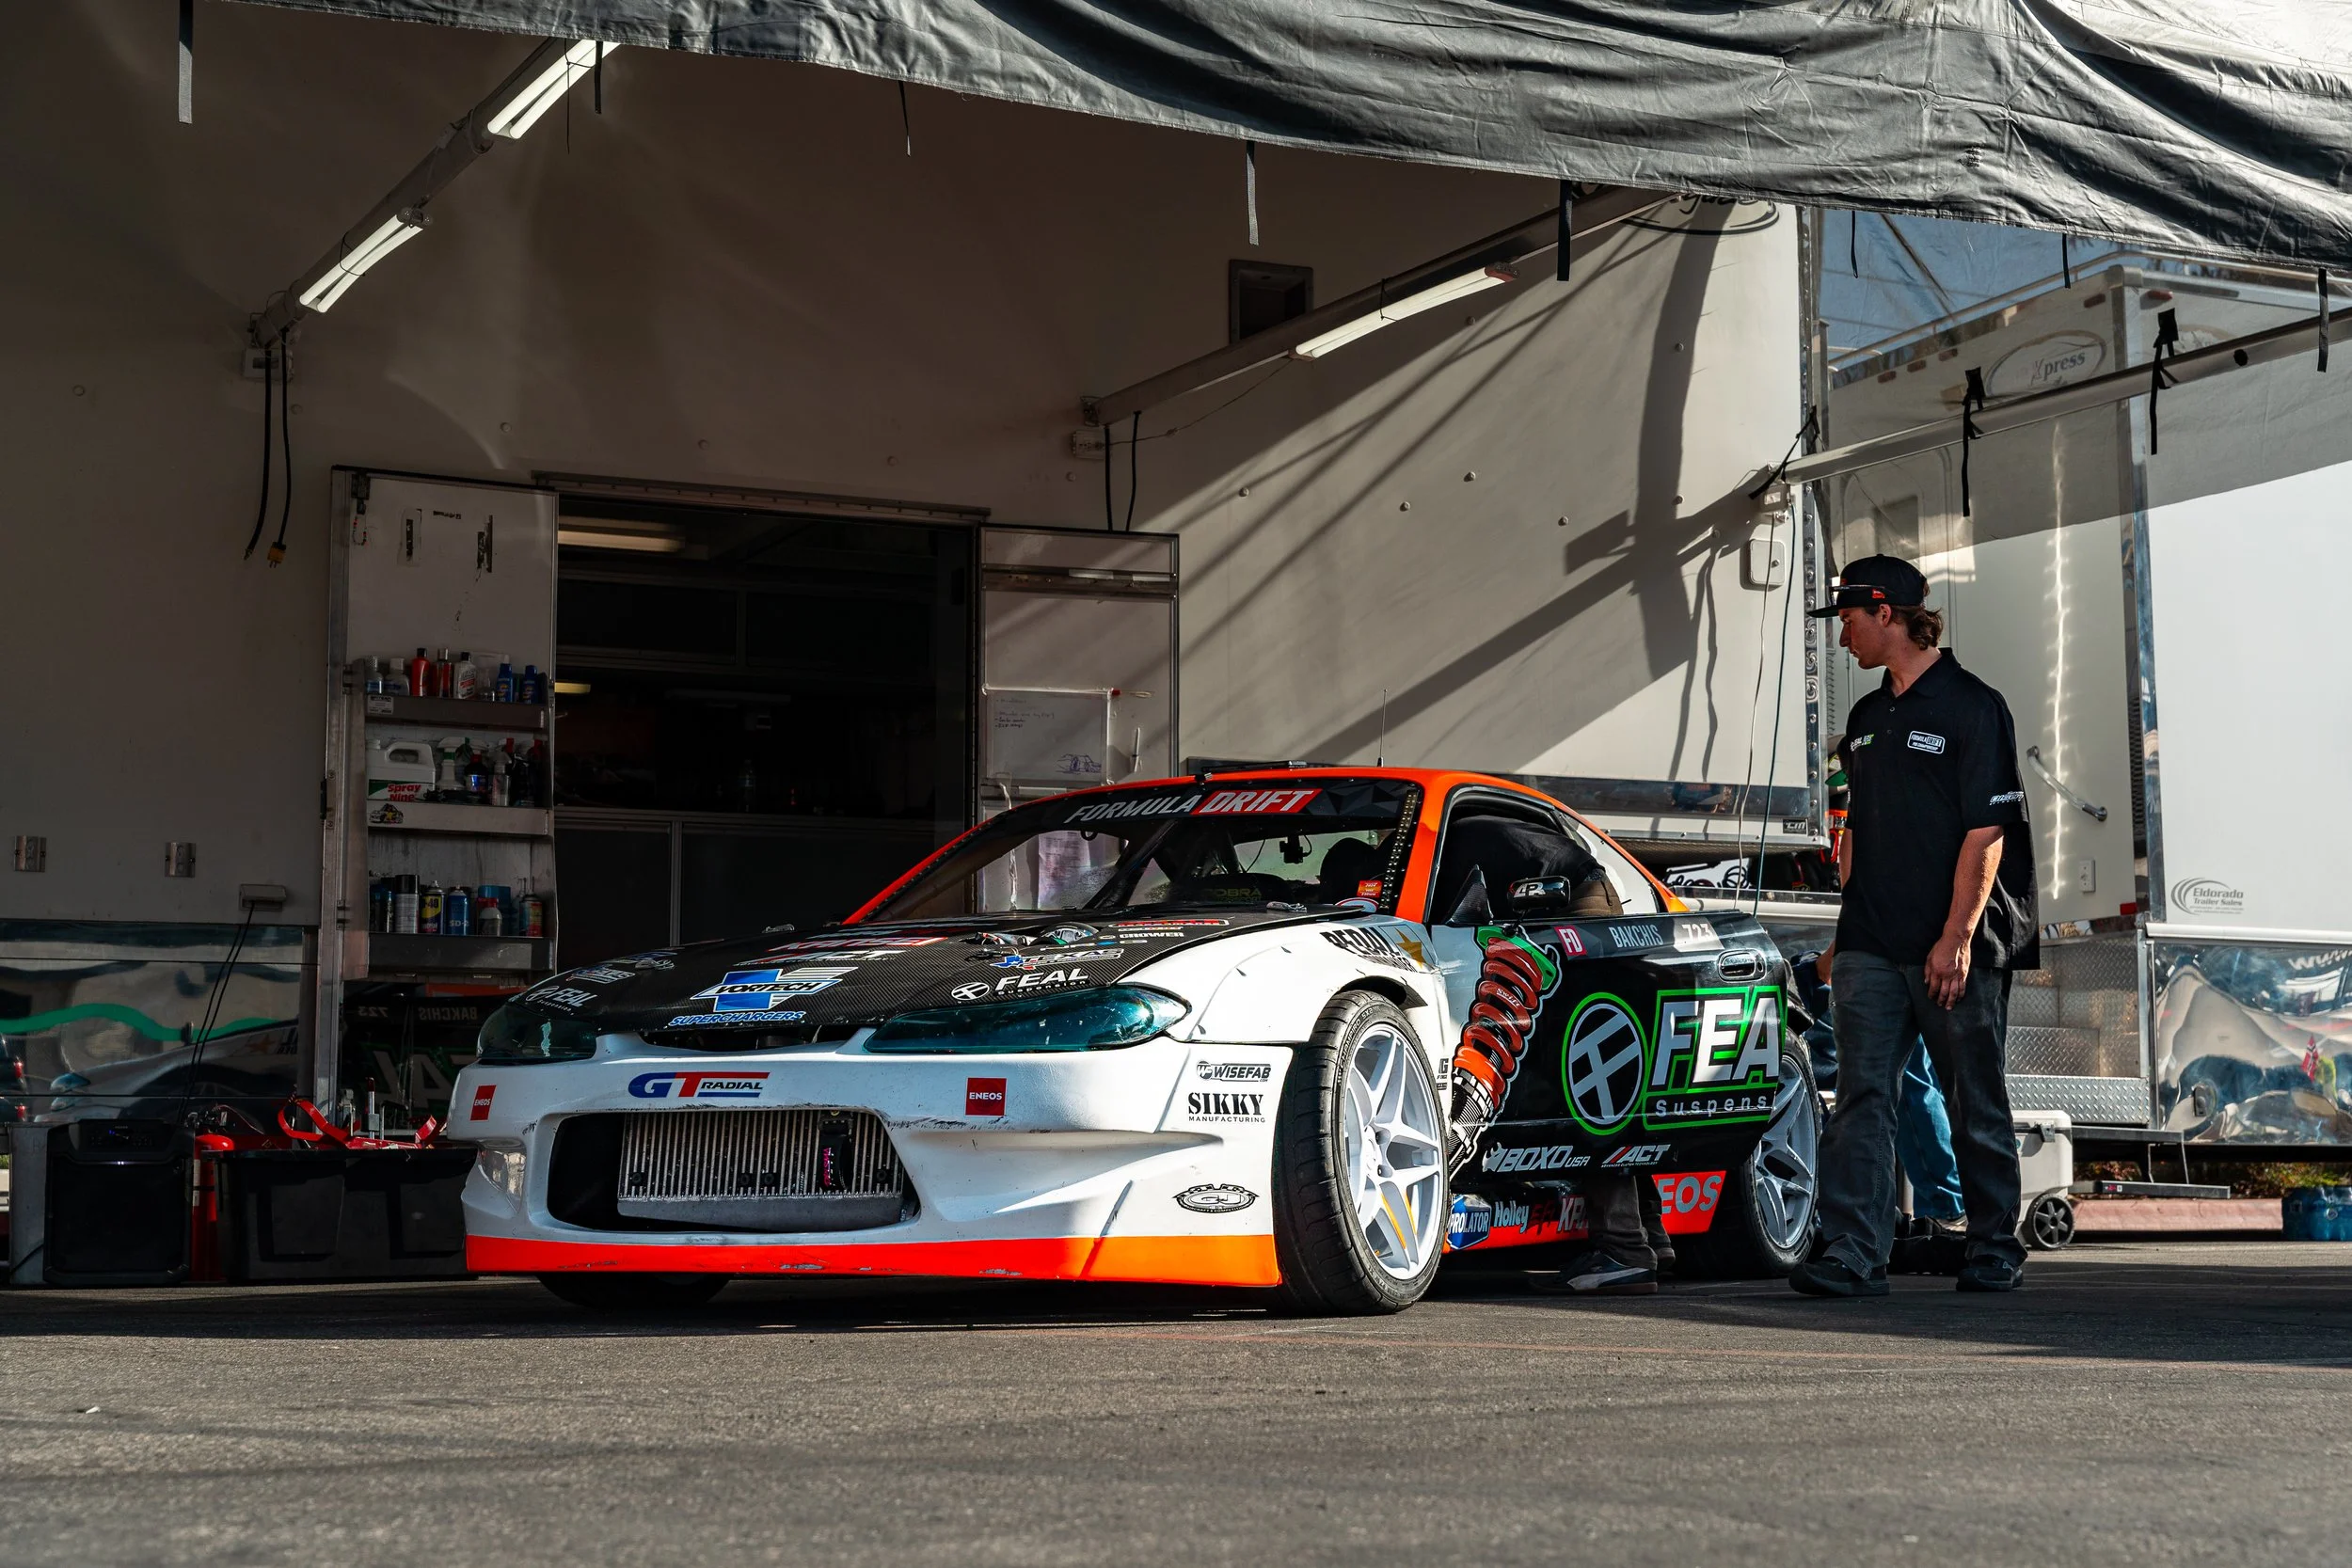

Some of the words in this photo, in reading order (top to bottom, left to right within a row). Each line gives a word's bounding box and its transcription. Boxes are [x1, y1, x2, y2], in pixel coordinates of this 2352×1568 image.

[387, 784, 421, 793] Spray
[389, 793, 414, 801] Nine
[1063, 794, 1202, 824] FORMULA
[1199, 790, 1314, 814] DRIFT
[2193, 887, 2244, 898] Eldorado
[1558, 927, 1583, 954] FD
[1608, 924, 1664, 948] BAKCHIS
[1681, 923, 1714, 941] 723
[715, 980, 829, 994] VORTECH
[995, 968, 1089, 991] FEAL
[545, 988, 598, 1007] FEAL
[668, 1010, 807, 1027] SUPERCHARGERS
[1340, 1019, 1361, 1069] CHAMPIRO
[1214, 1065, 1271, 1079] WISEFAB
[701, 1081, 764, 1091] RADIAL
[474, 1098, 492, 1107] ENEOS
[969, 1091, 1003, 1101] ENEOS
[1187, 1092, 1263, 1116] SIKKY
[1497, 1145, 1574, 1172] BOXO
[1565, 1155, 1591, 1168] USA
[1616, 1144, 1672, 1164] ACT
[1658, 1176, 1723, 1213] EOS
[1493, 1199, 1530, 1234] Holley
